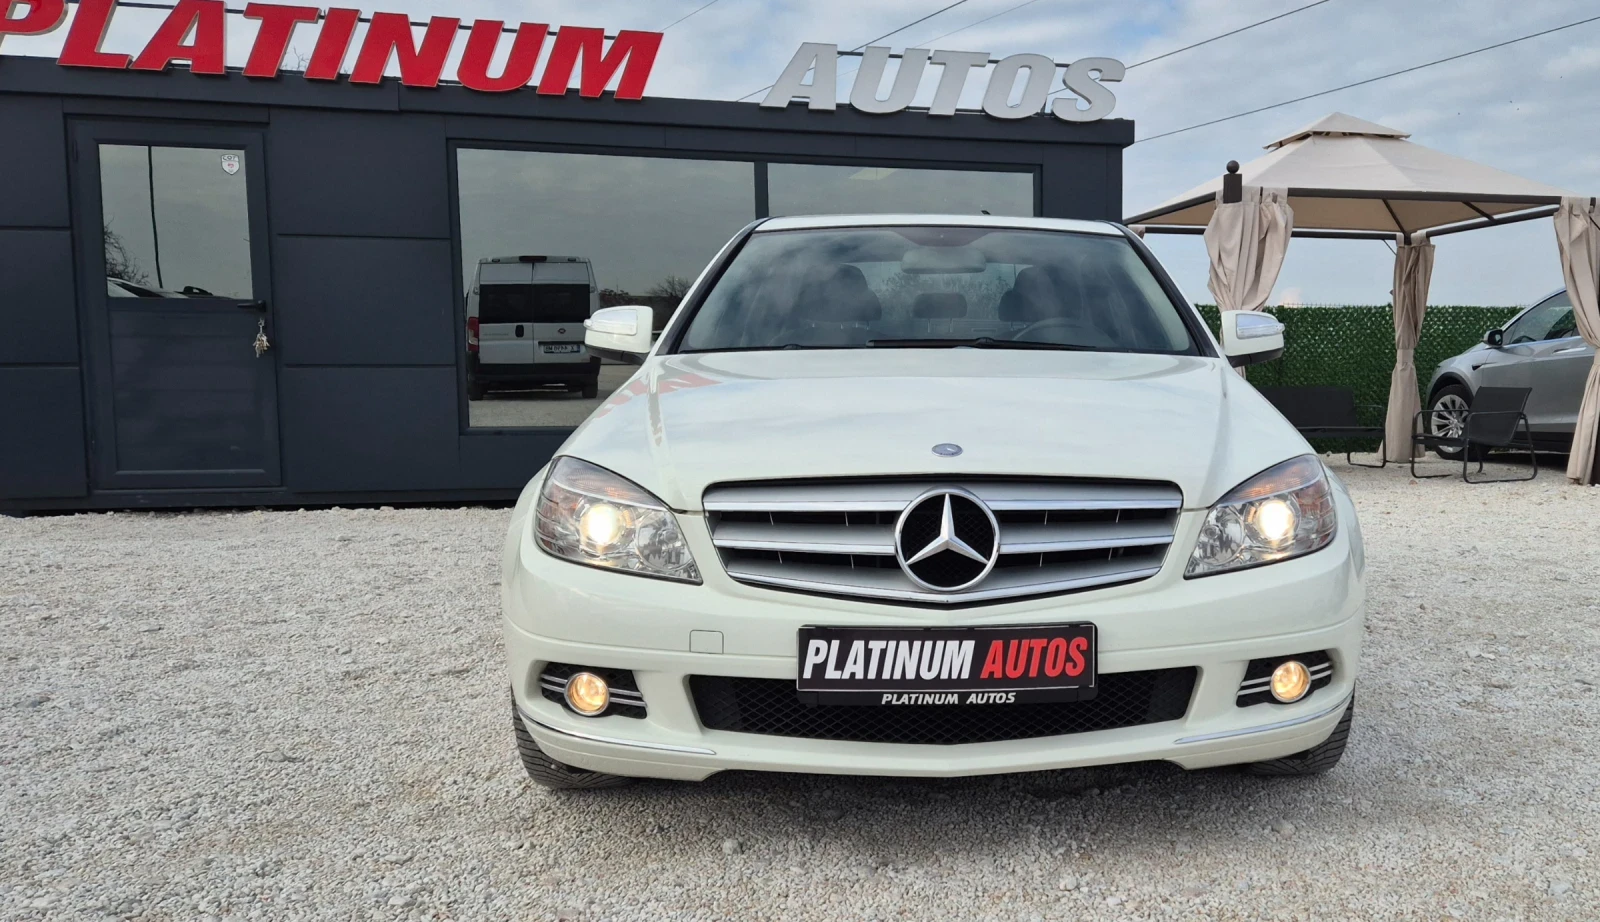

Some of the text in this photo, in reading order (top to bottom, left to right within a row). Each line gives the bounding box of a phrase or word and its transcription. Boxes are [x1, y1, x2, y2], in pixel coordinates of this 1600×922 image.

[760, 42, 1126, 122] AUTOS
[803, 637, 1088, 680] PLATINUM AUTOS
[881, 692, 1016, 705] PLATINUM AUTOS
